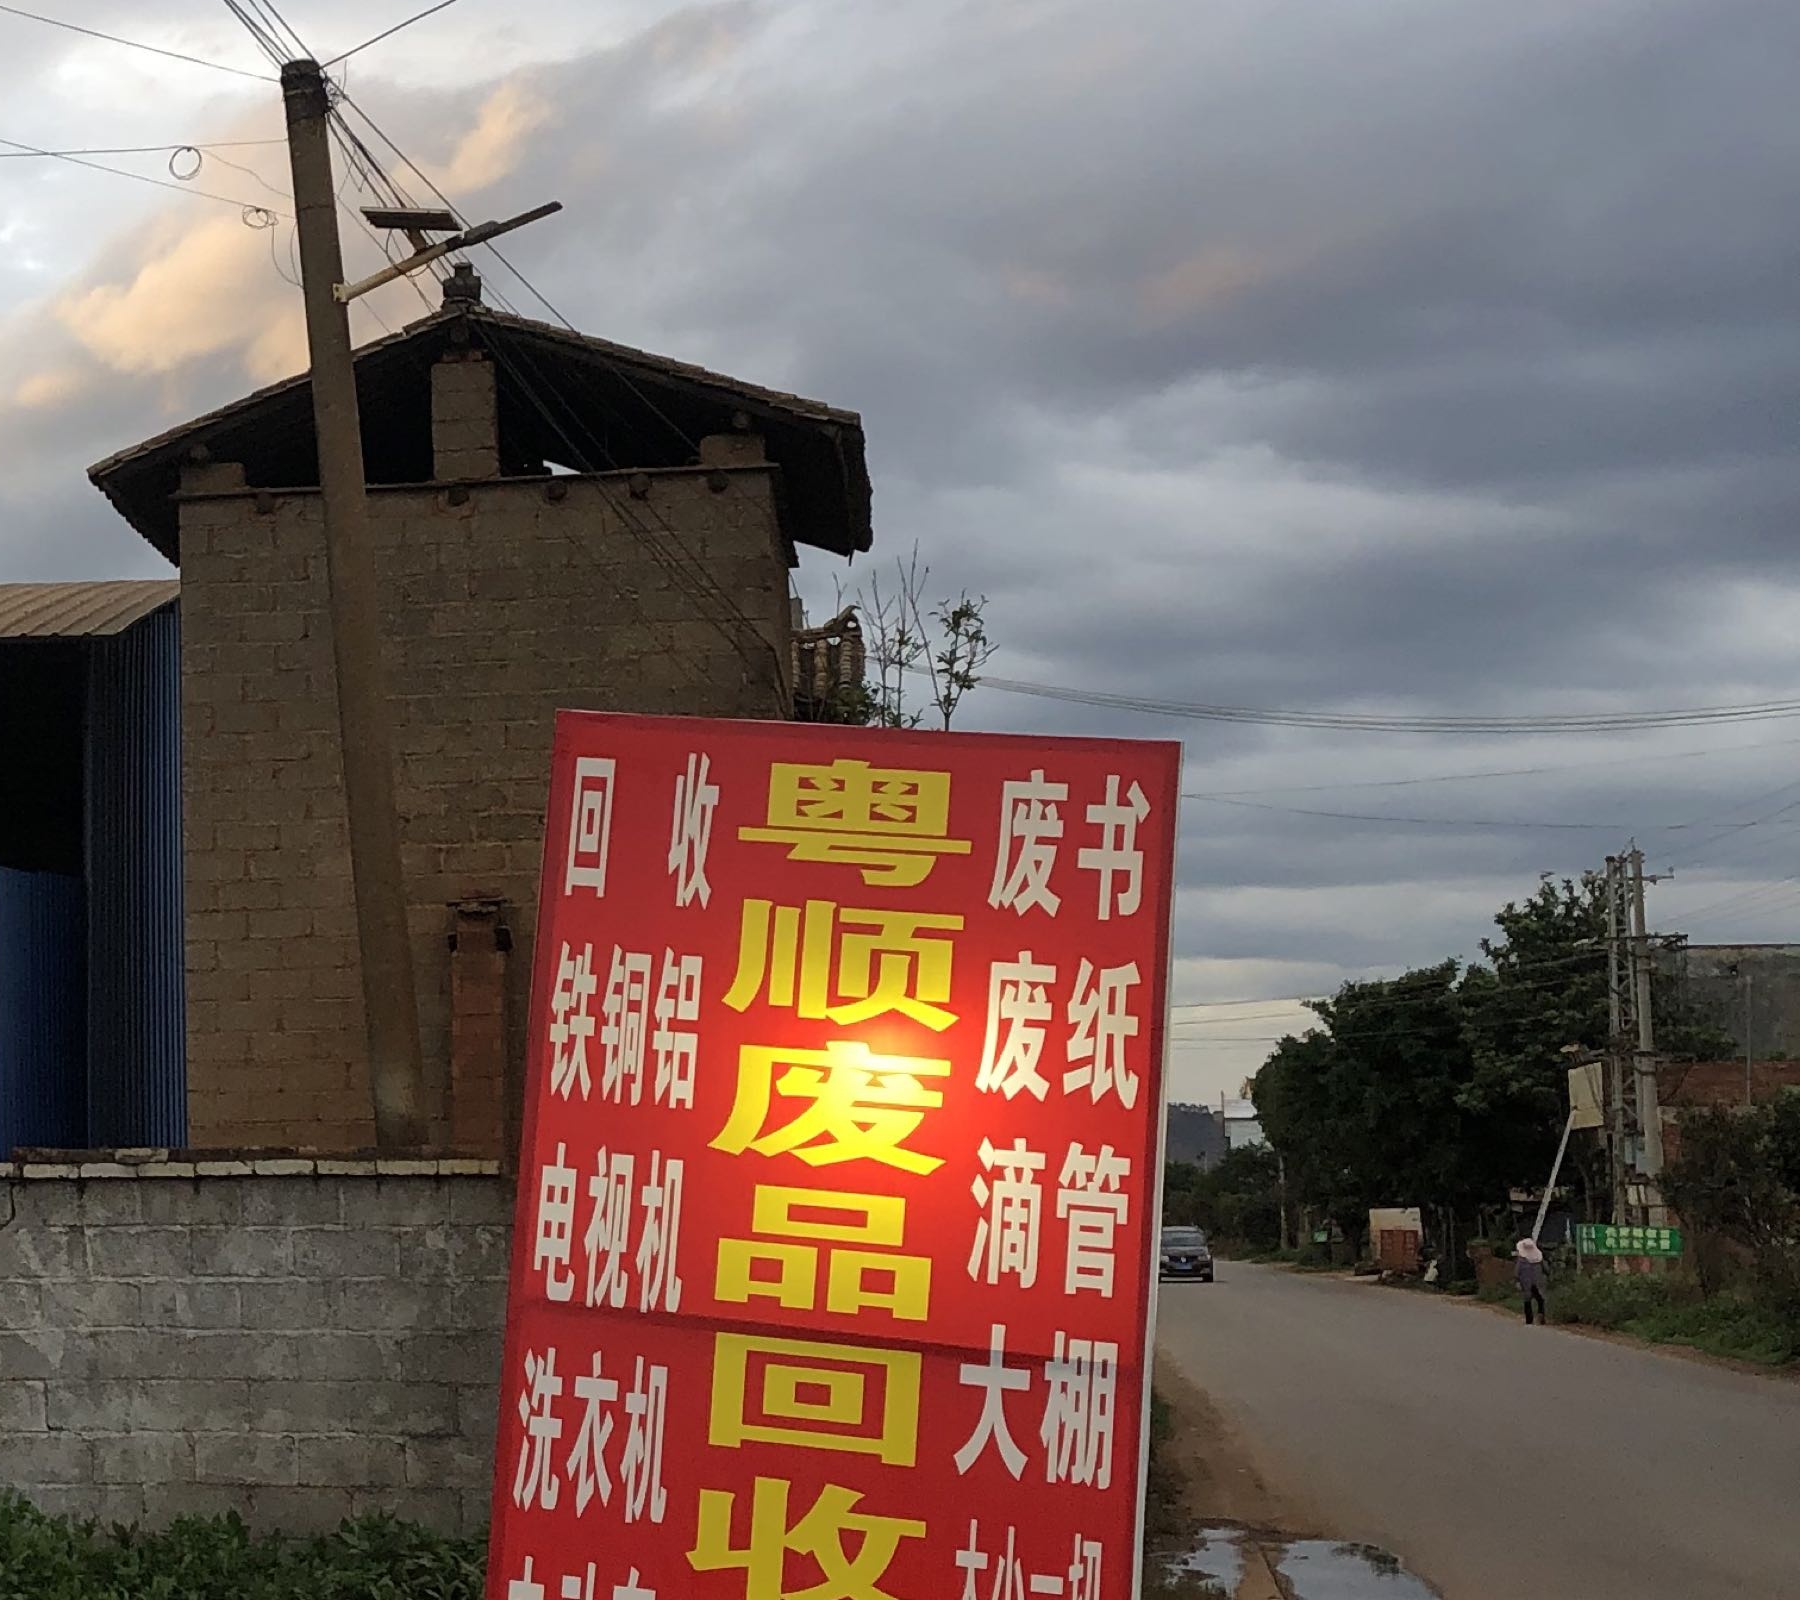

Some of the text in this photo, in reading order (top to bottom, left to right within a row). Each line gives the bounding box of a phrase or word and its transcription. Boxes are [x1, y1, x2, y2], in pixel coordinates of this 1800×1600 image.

[564, 752, 720, 910] 回收
[986, 769, 1152, 921] 废书
[548, 941, 703, 1110] 铁铜铝
[974, 950, 1141, 1111] 废纸
[532, 1141, 685, 1314] 电视机
[967, 1136, 1132, 1298] 滴管
[513, 1346, 669, 1524] 洗衣机
[953, 1323, 1119, 1491] 大棚
